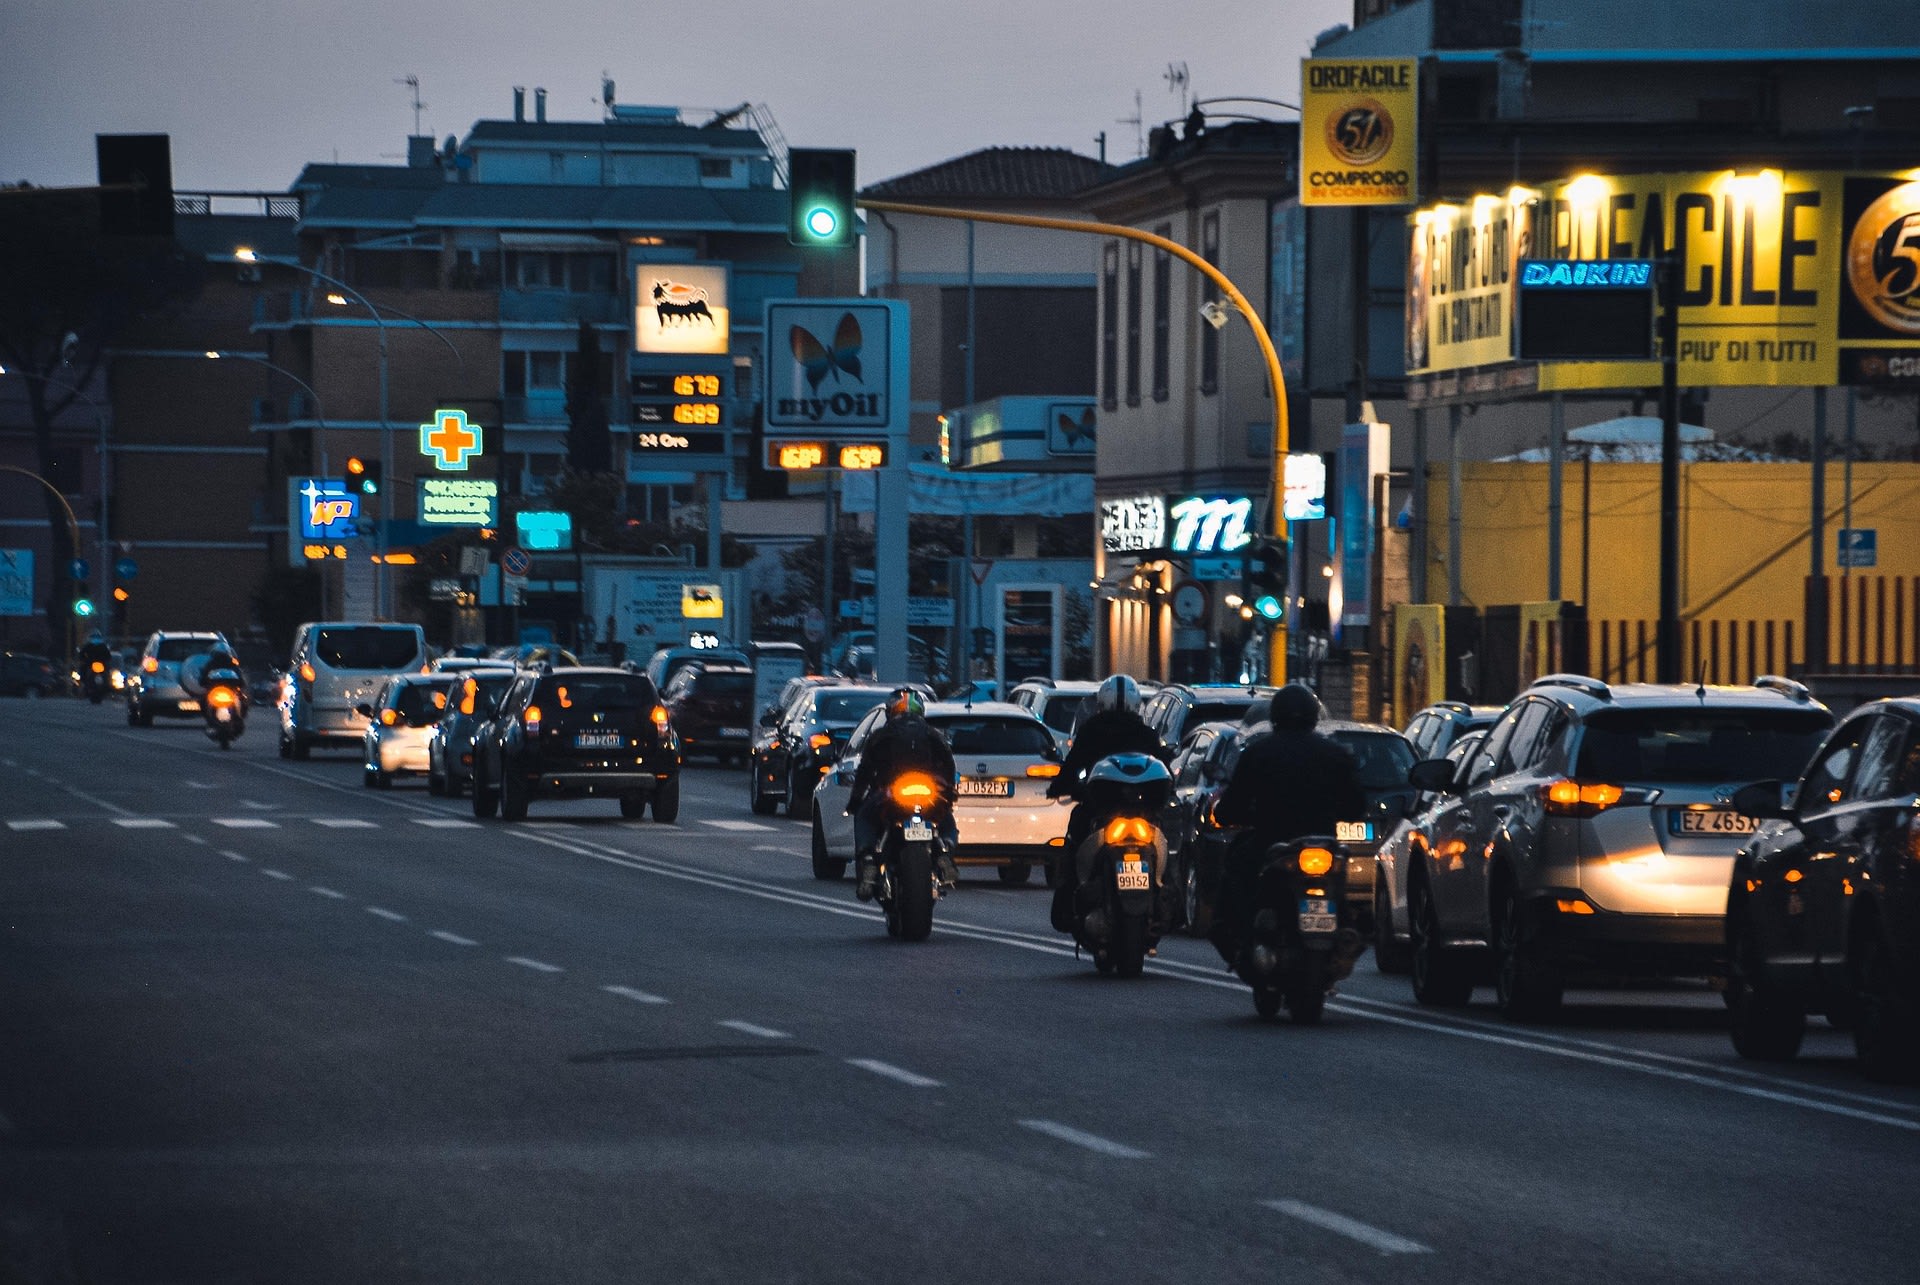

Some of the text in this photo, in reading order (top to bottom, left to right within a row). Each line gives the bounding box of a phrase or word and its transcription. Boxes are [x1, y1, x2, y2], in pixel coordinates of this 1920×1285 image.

[1310, 65, 1410, 87] OROFACILE
[1310, 170, 1410, 186] COMPRORO
[1522, 264, 1651, 285] DAIKIN
[1728, 341, 1749, 361] DI
[1757, 341, 1817, 361] TUTTI
[674, 375, 719, 396] 1679
[673, 403, 719, 424] 1689
[777, 393, 880, 421] myOil
[639, 433, 689, 448] 24 Ore
[1683, 813, 1705, 831] EZ
[1120, 876, 1148, 888] 99152
